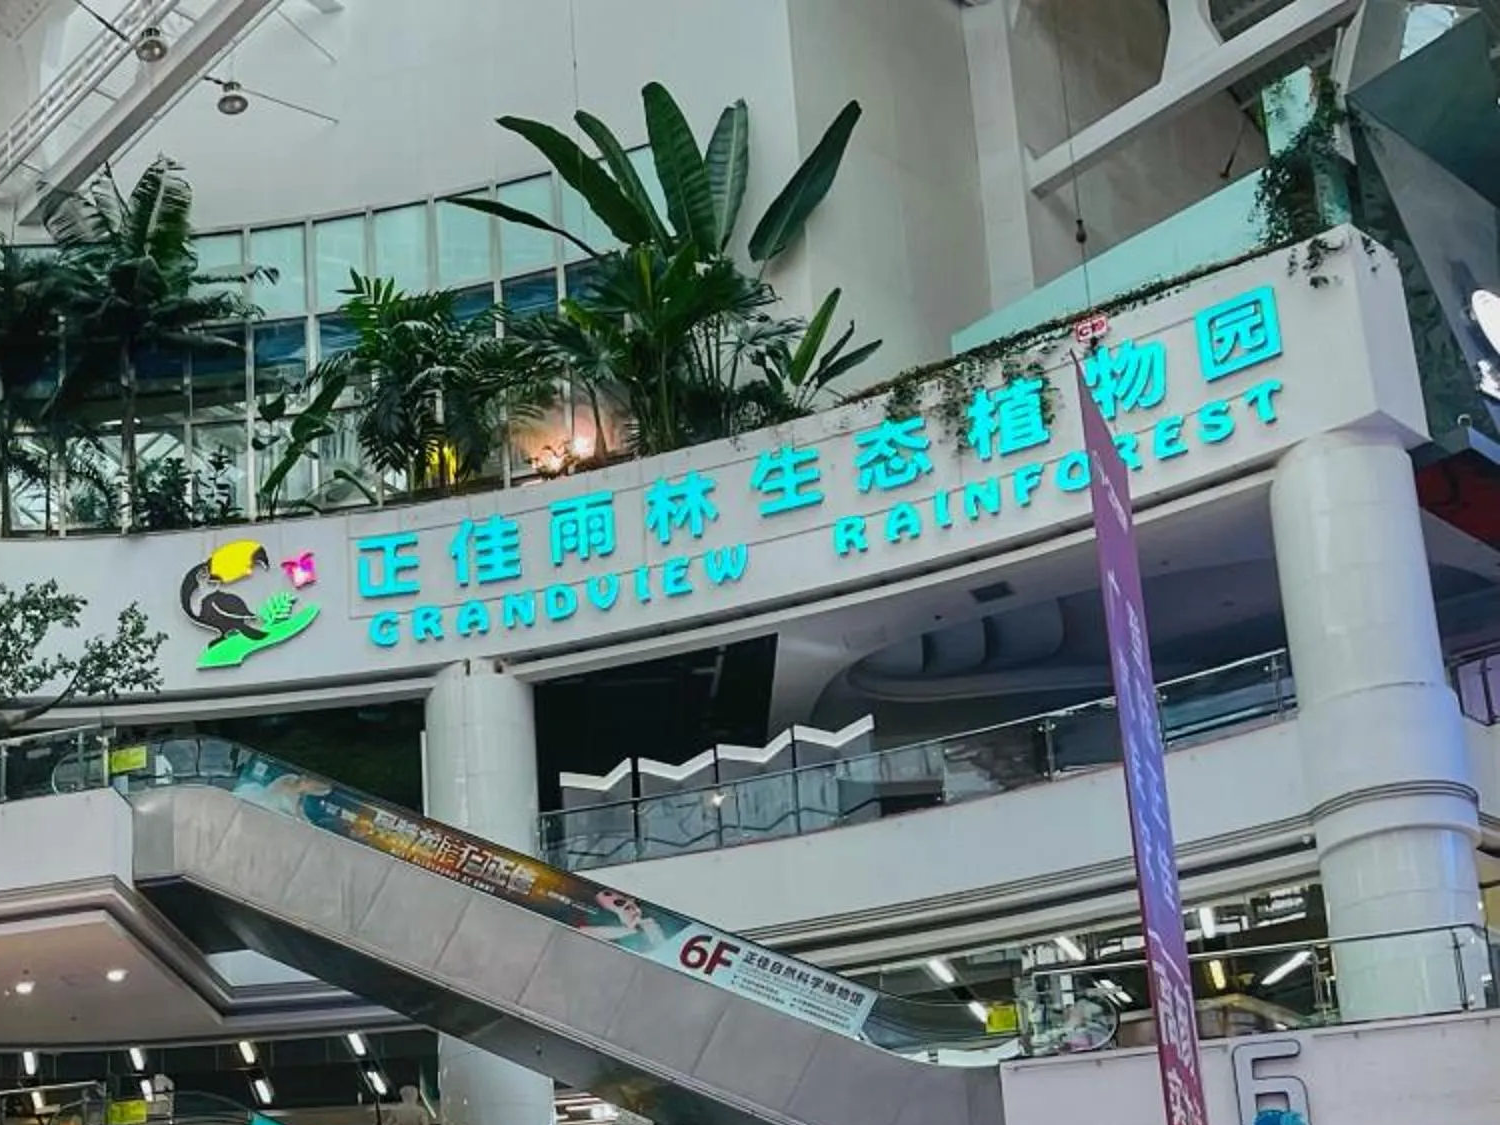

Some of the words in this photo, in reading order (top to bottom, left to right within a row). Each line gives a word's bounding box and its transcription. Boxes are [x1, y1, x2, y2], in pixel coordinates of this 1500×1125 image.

[356, 286, 1284, 599] 正佳雨林生态植物园
[368, 543, 750, 647] GRANDVIEW
[834, 379, 1283, 556] RAINFOREST
[678, 933, 740, 977] 6F
[743, 950, 865, 1008] 正佳自然科学博物馆
